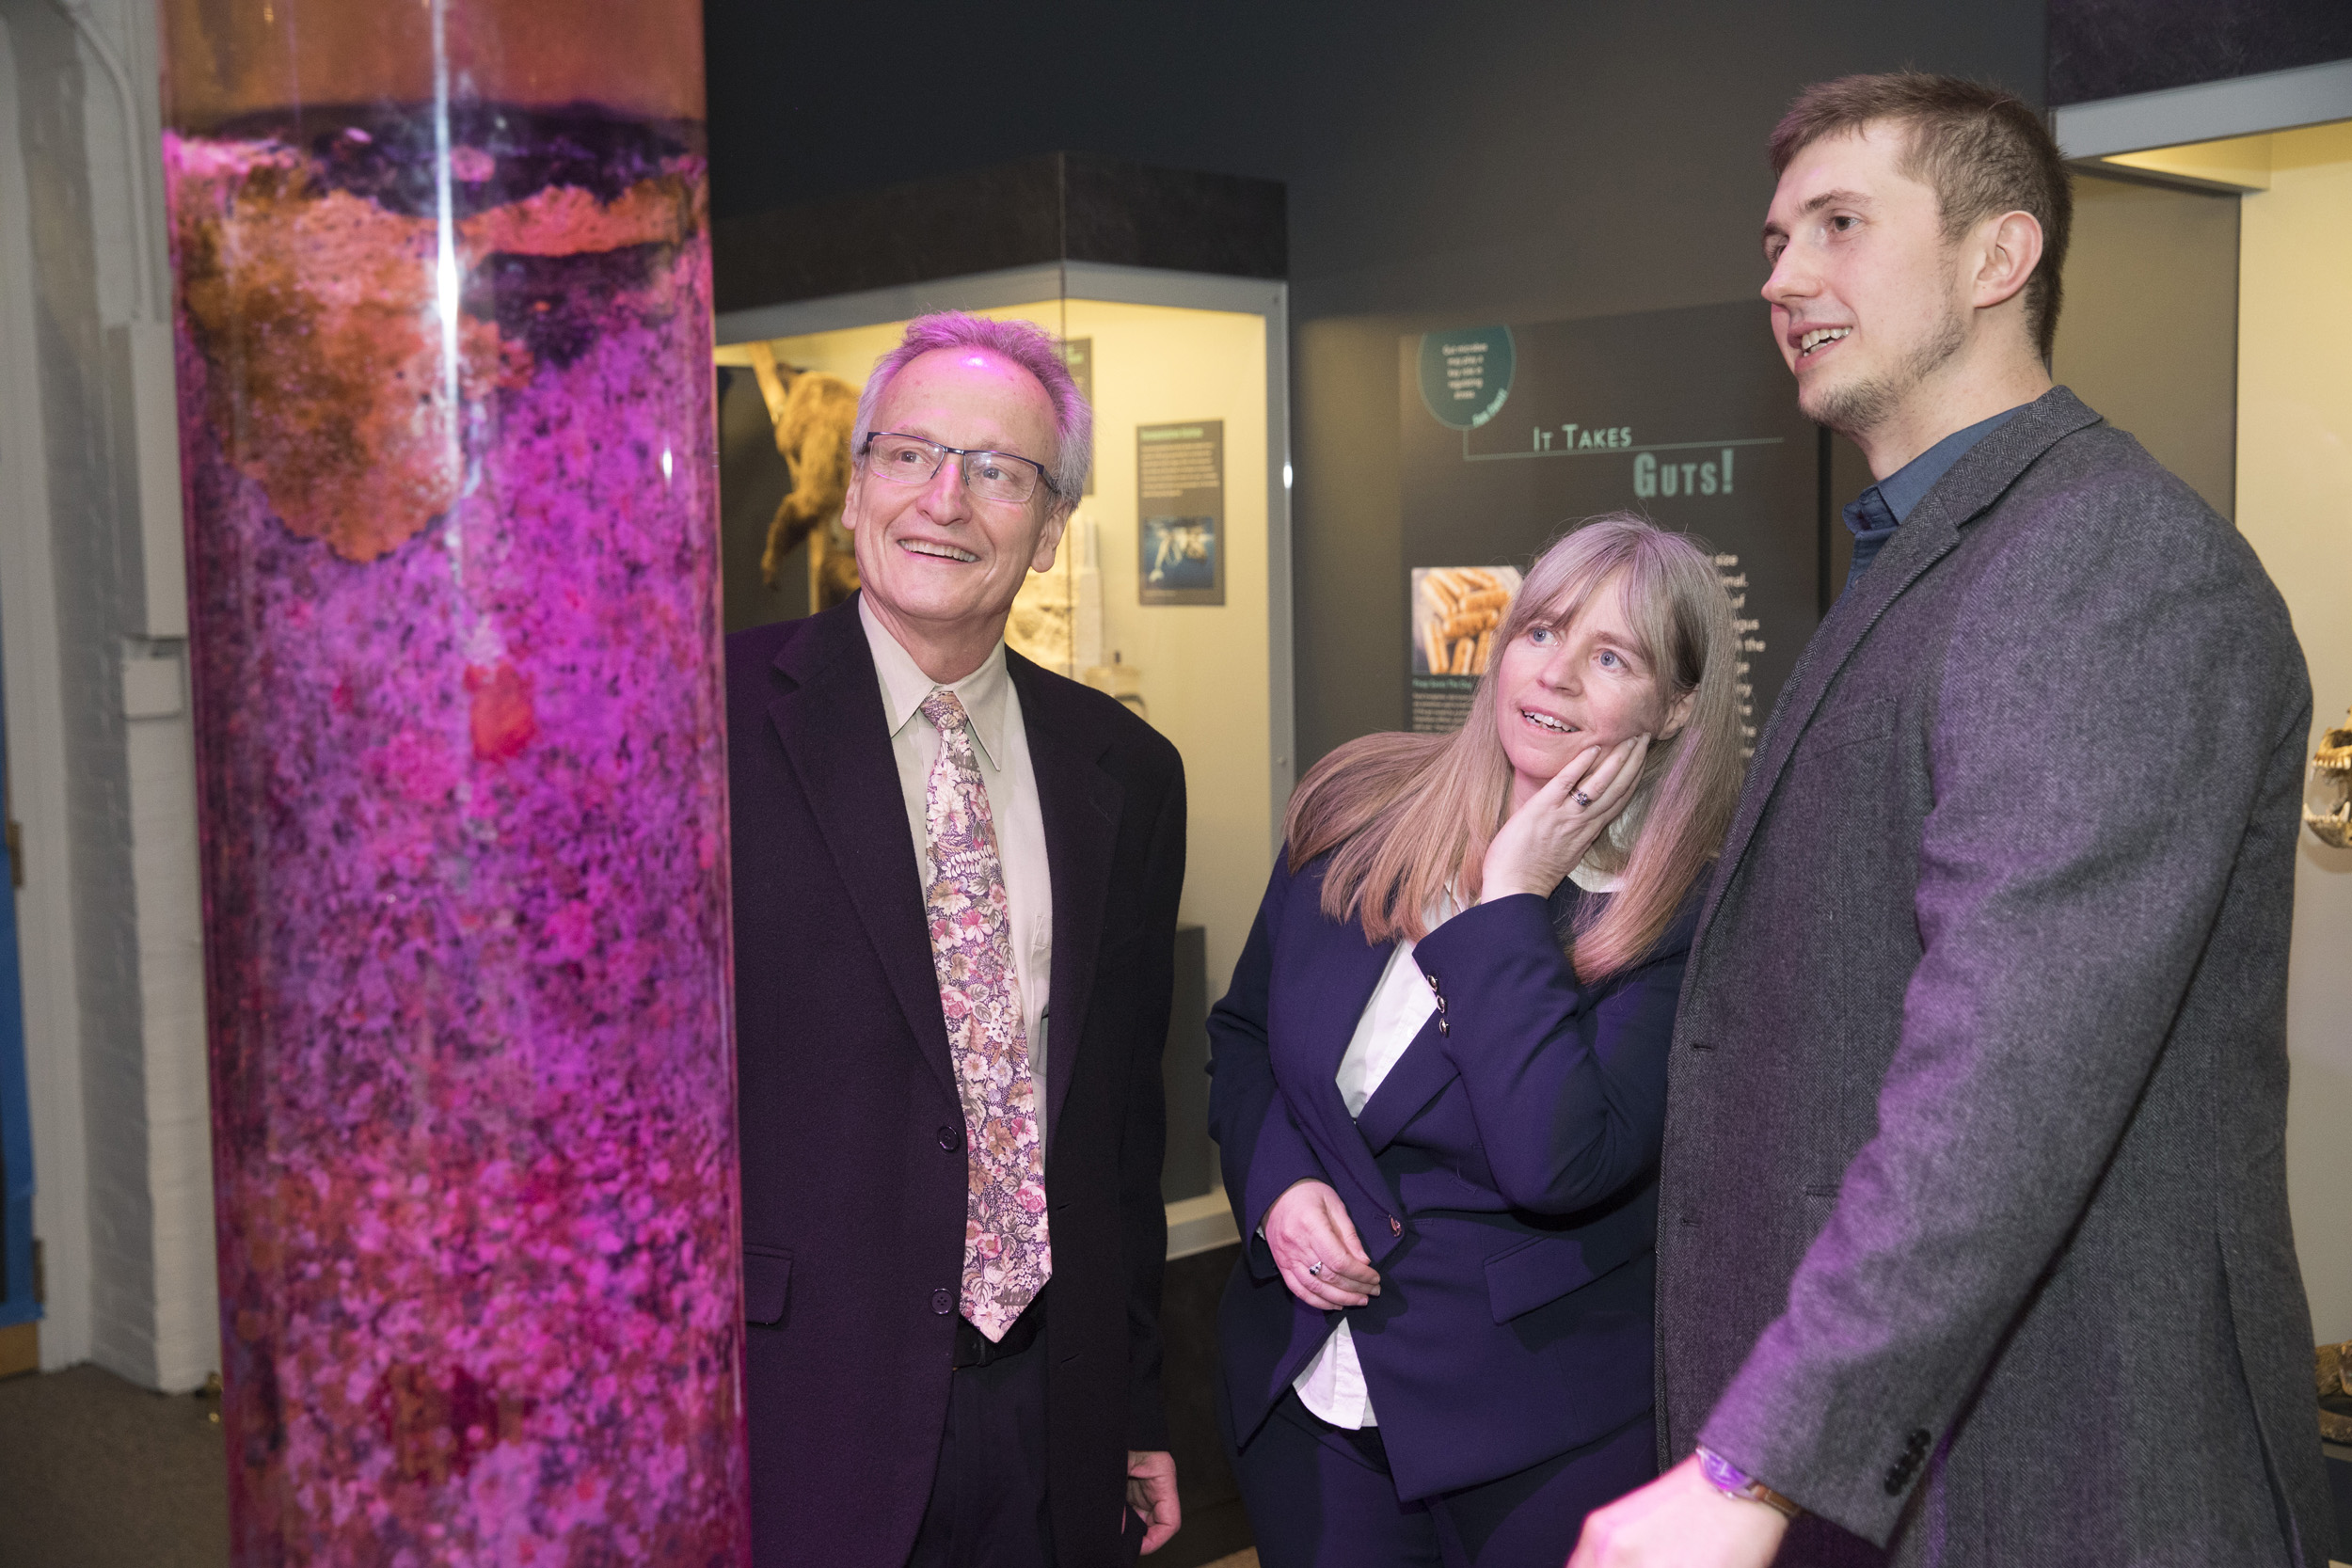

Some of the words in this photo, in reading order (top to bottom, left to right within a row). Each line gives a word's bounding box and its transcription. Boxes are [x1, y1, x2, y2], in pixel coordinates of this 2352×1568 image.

[1534, 426, 1553, 451] It
[1562, 423, 1632, 450] Takes
[1633, 449, 1735, 498] Guts!
[1745, 636, 1766, 652] the
